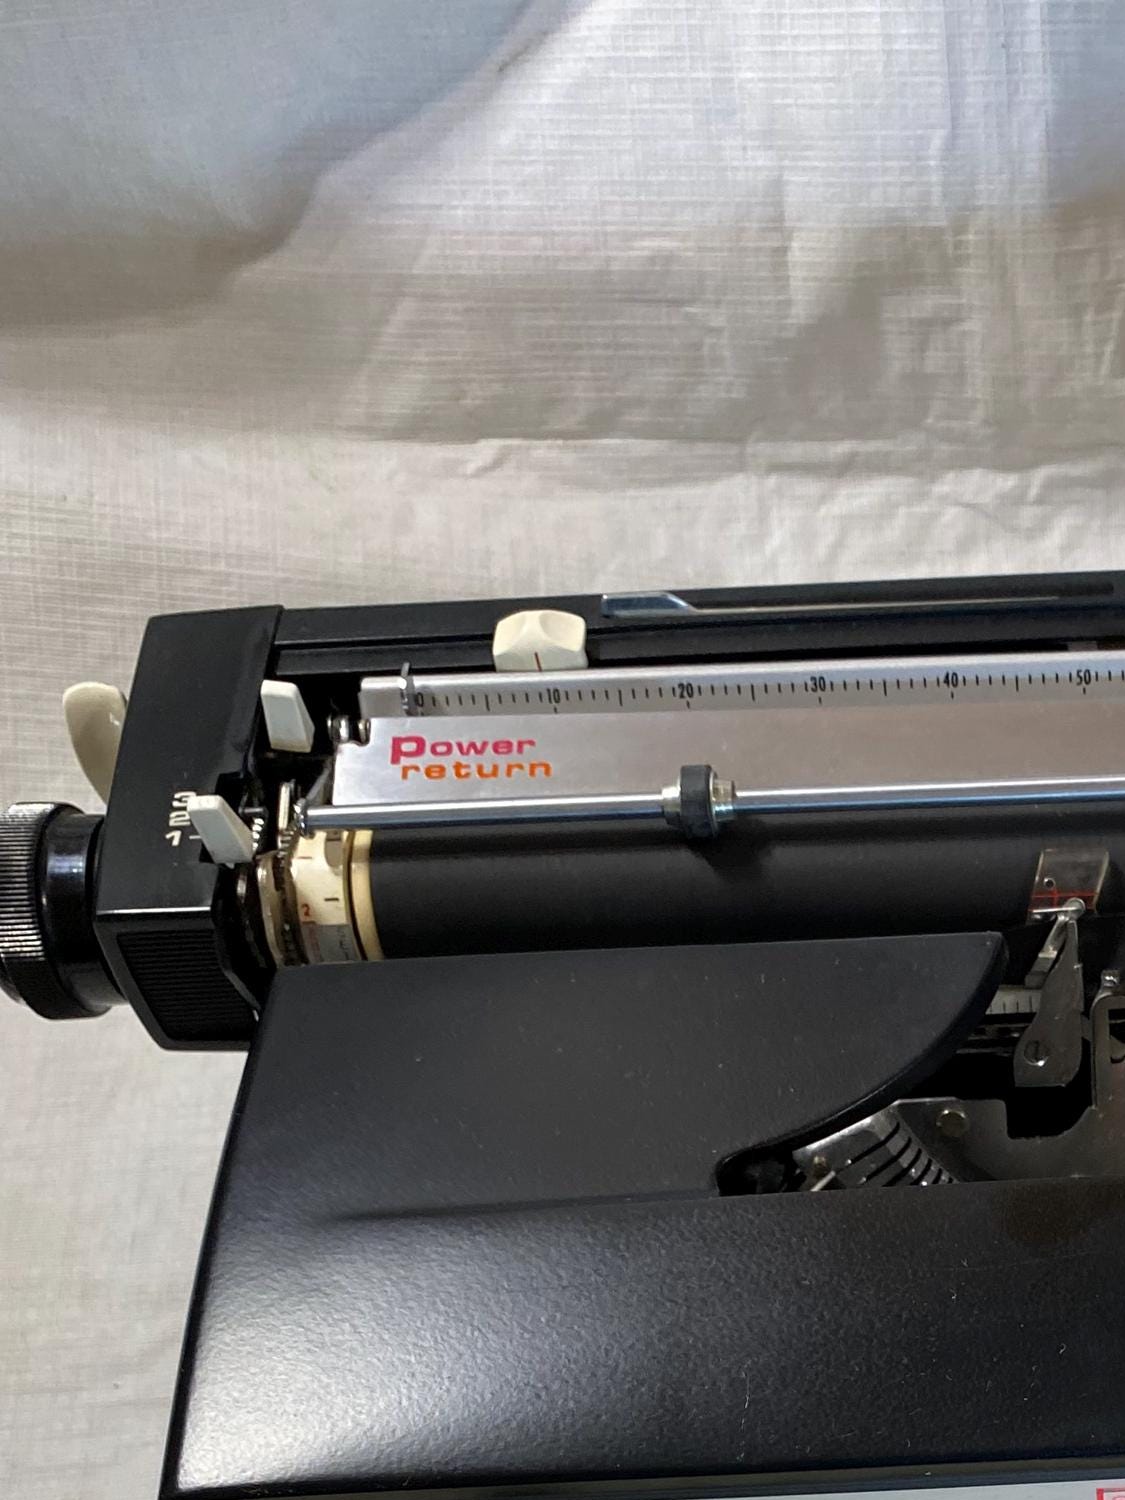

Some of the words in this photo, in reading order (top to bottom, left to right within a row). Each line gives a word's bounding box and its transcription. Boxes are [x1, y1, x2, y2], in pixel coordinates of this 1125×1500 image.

[546, 689, 560, 704] 10
[678, 683, 694, 698] 20
[810, 676, 826, 694] 30
[943, 672, 958, 689] 40
[1076, 668, 1091, 686] 50
[401, 761, 552, 780] return
[168, 811, 191, 827] 2
[165, 830, 182, 846] 1
